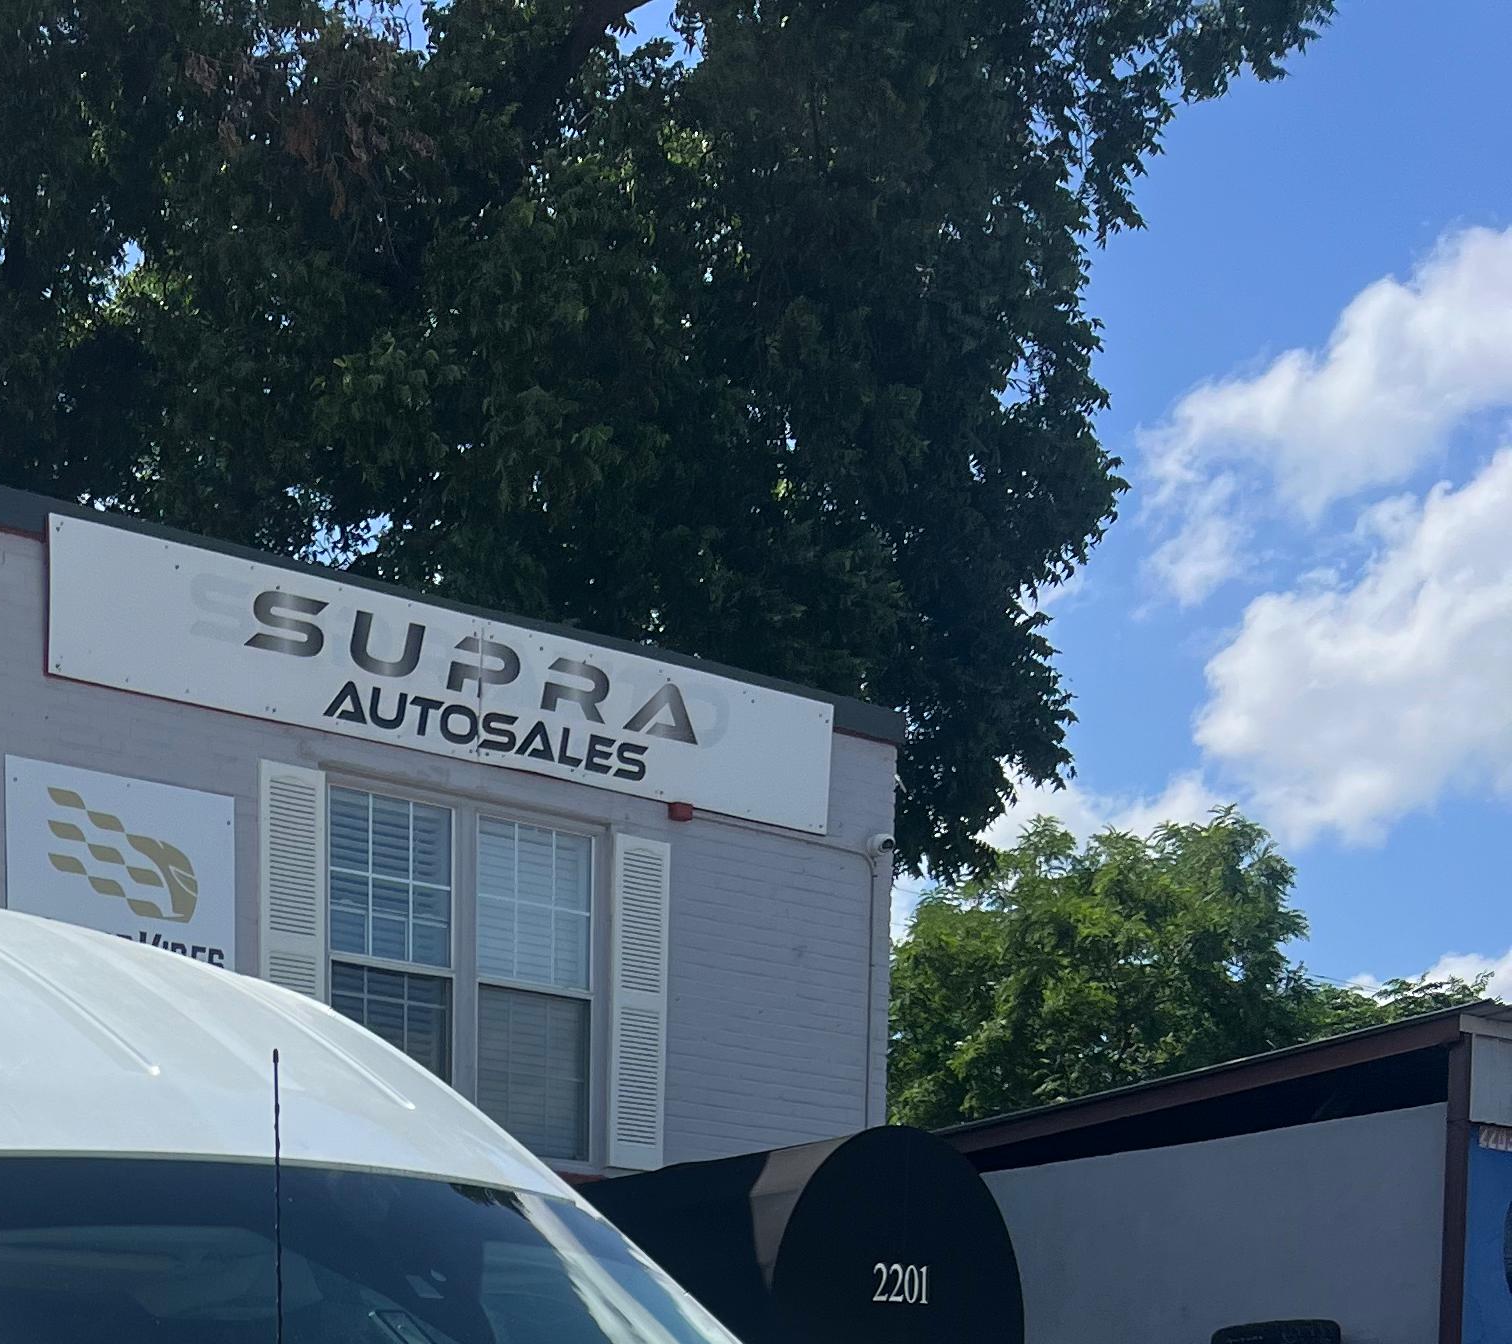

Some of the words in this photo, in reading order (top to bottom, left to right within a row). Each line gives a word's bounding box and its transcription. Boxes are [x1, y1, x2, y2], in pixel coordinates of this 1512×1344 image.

[244, 590, 698, 746] SUPRA
[323, 681, 649, 782] AUTOSALES
[872, 1262, 928, 1304] 2201
